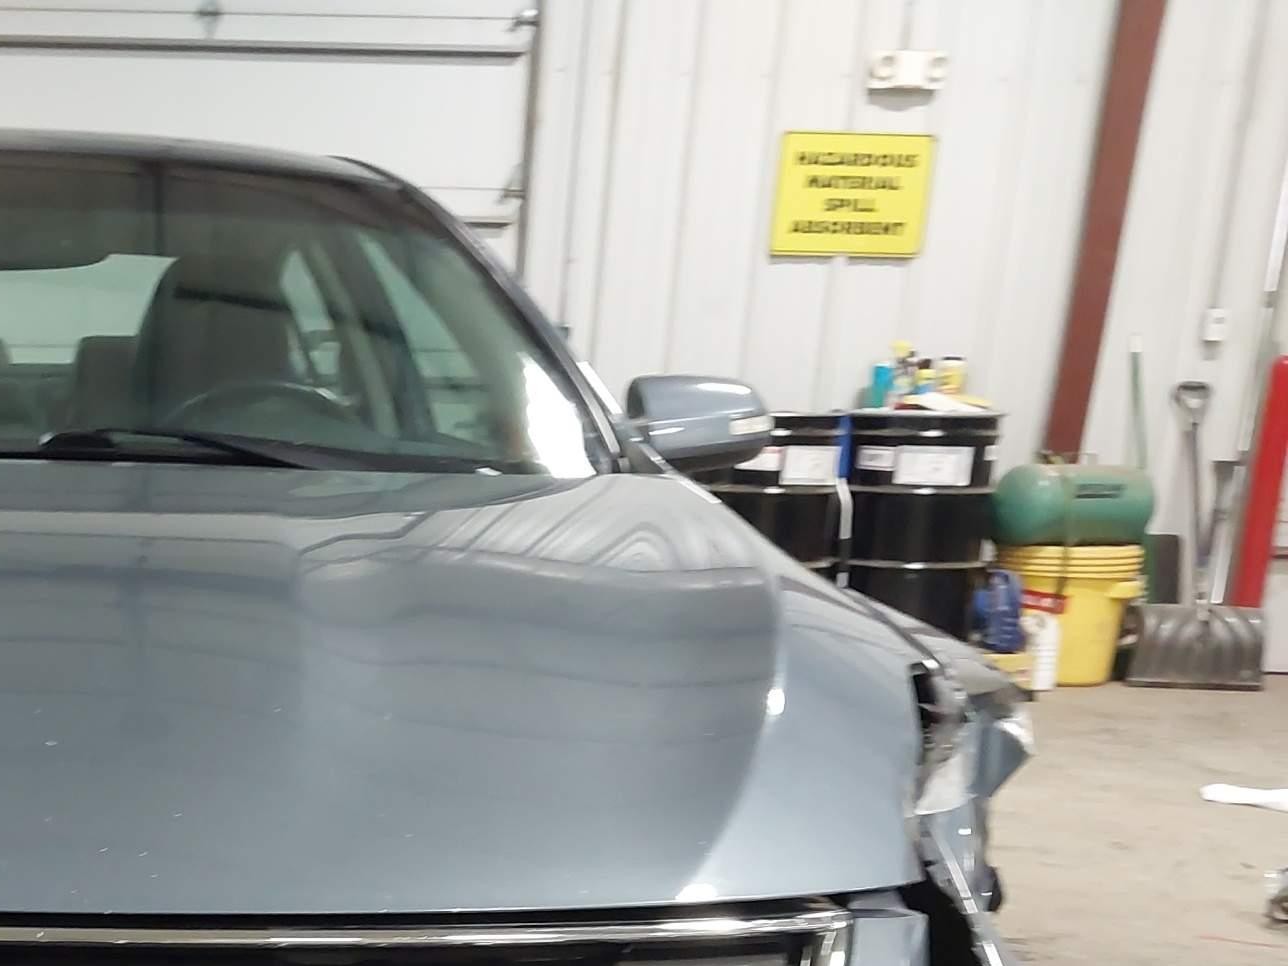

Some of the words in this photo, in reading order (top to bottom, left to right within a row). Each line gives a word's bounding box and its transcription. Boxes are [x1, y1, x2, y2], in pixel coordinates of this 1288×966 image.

[795, 152, 918, 167] HAZARDOUS
[806, 175, 902, 190] MATERIAL
[824, 198, 876, 212] SPILL
[790, 220, 905, 235] ABSORBENT
